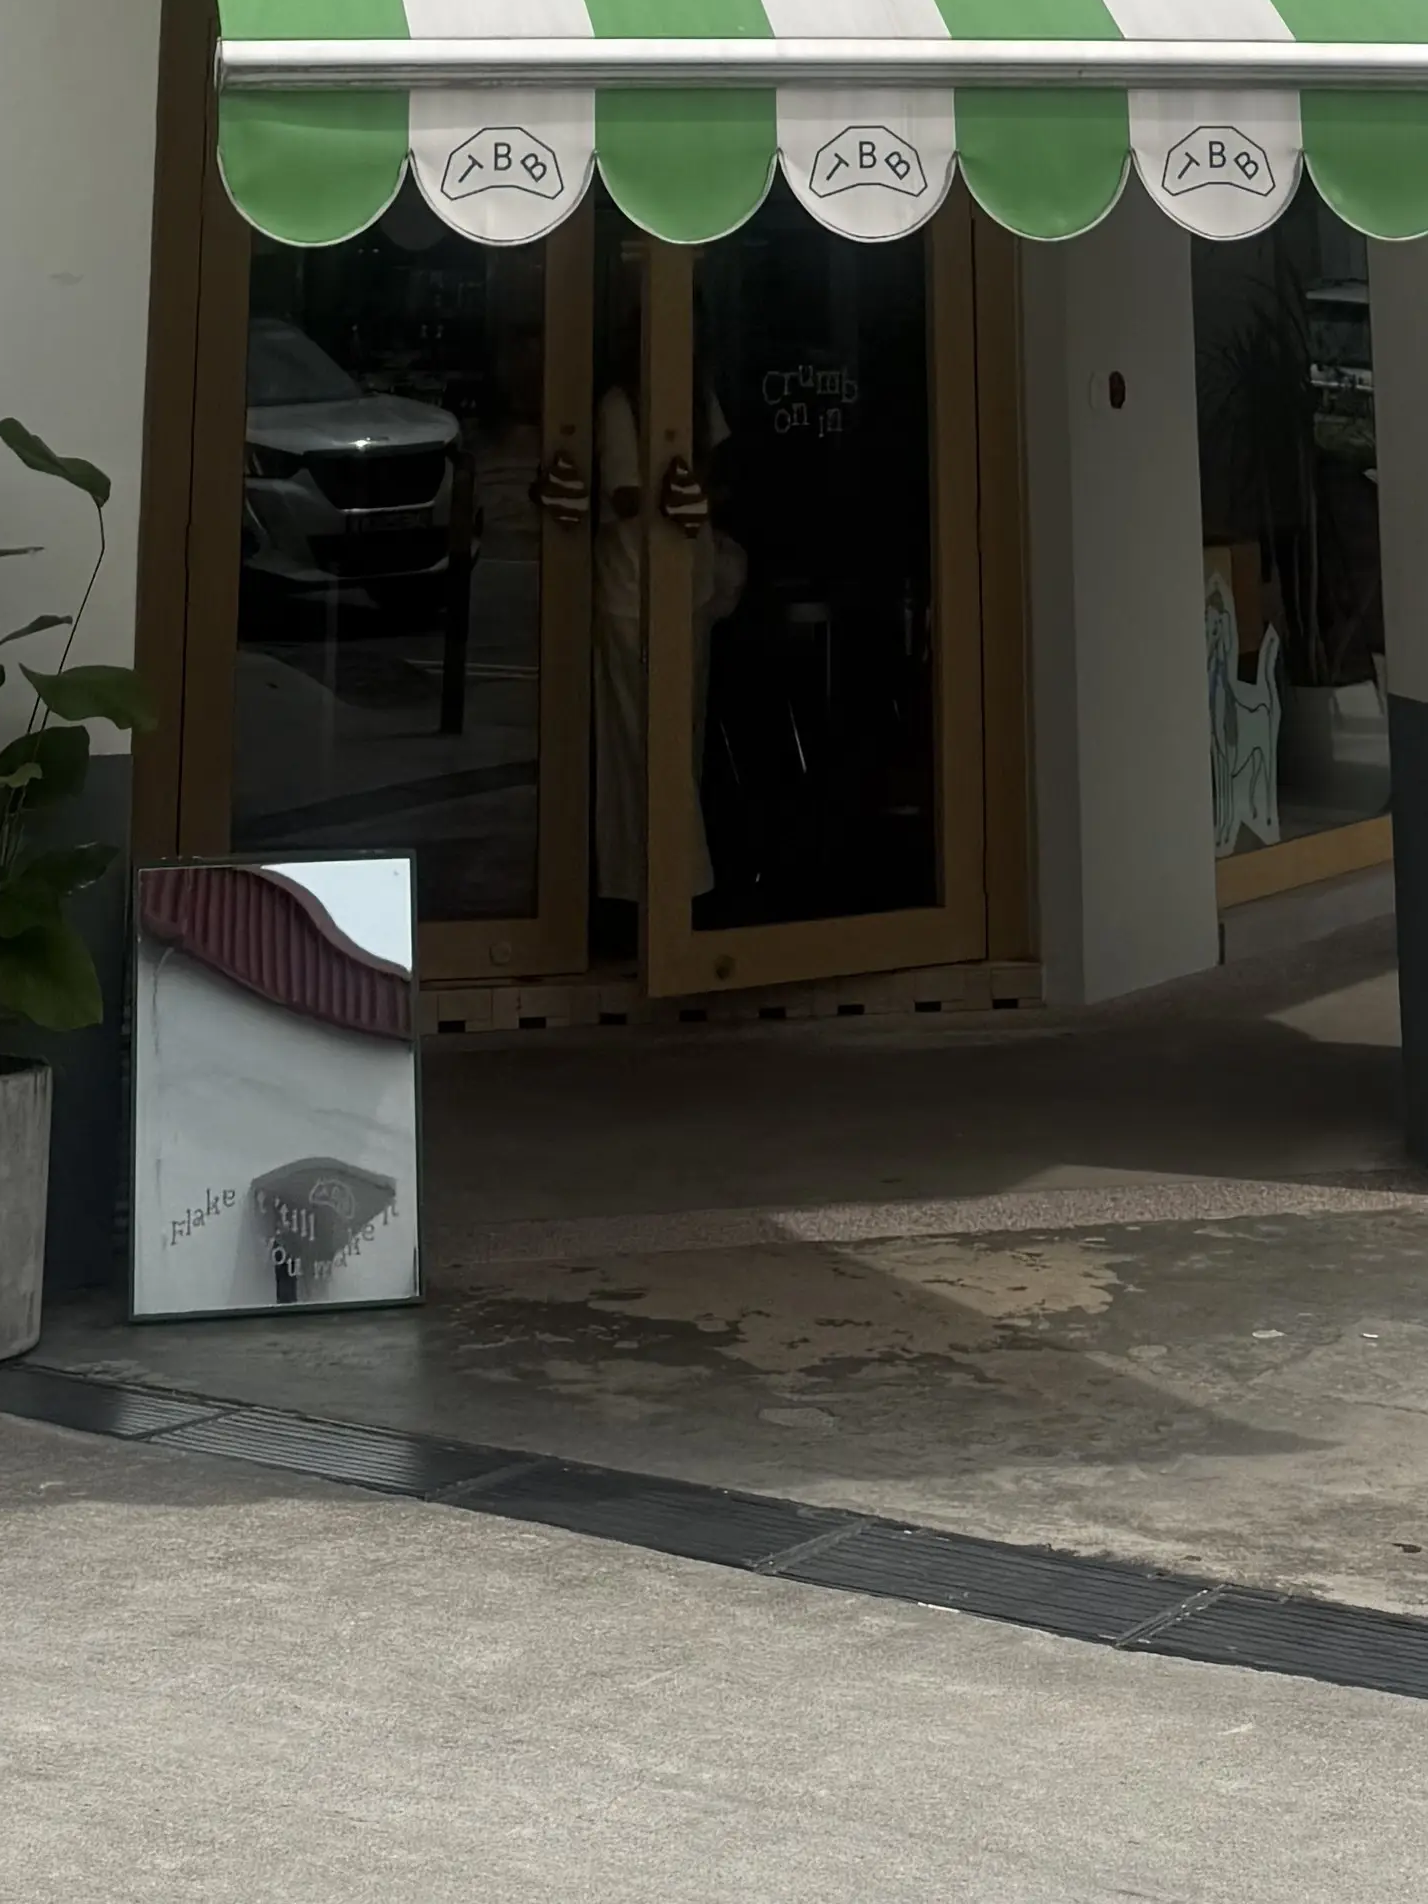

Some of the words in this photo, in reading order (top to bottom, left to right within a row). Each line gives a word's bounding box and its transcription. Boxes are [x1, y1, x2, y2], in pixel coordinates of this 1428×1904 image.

[457, 141, 548, 183] TBB
[825, 140, 912, 181] TBB
[1176, 140, 1260, 181] TBB
[762, 365, 858, 405] Crumb
[775, 402, 811, 433] on
[818, 408, 844, 438] in
[170, 1186, 236, 1246] Flake
